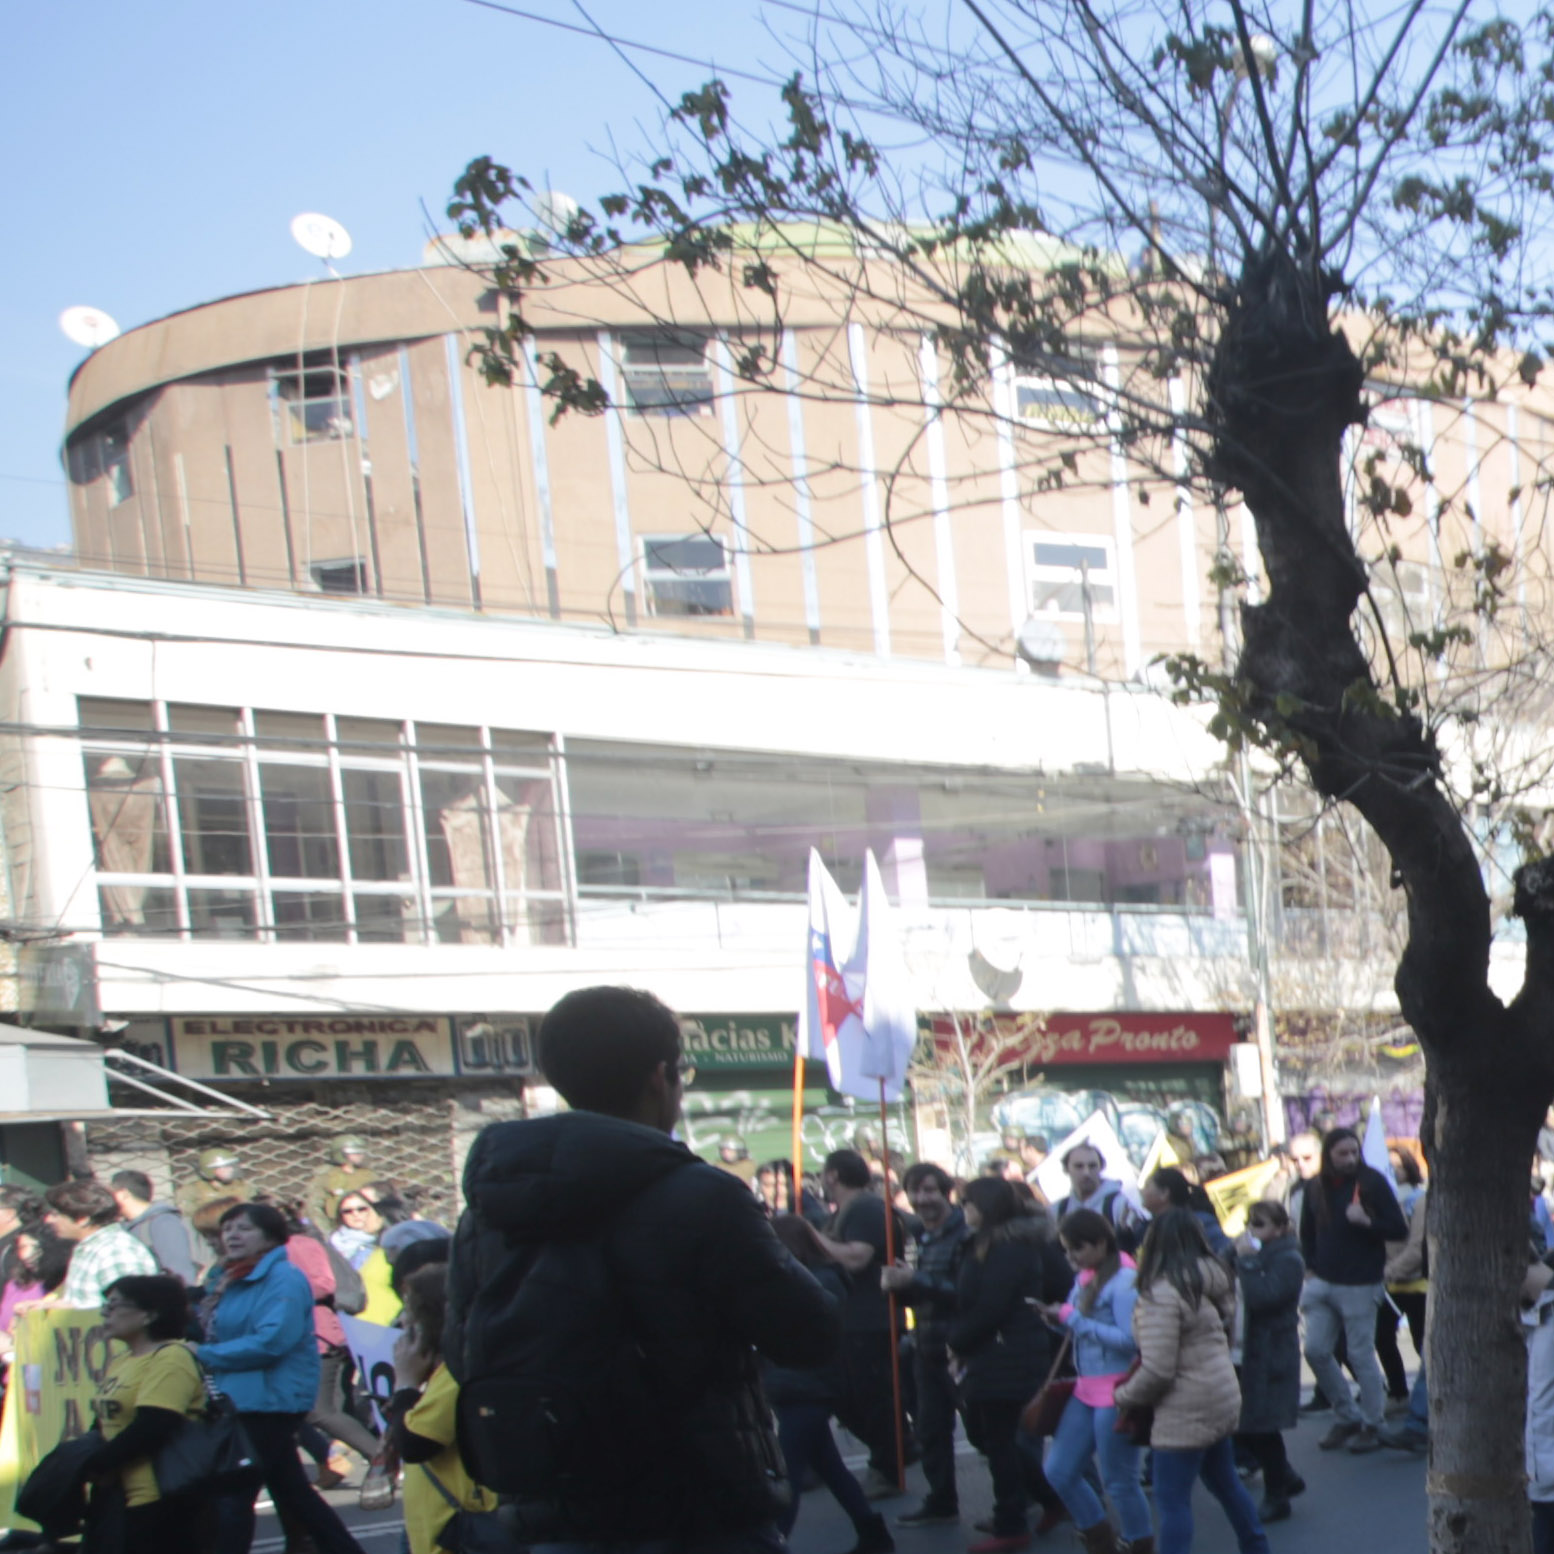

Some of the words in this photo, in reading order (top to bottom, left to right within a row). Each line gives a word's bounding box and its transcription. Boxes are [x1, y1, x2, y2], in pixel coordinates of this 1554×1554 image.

[183, 1018, 439, 1036] ELECTRONICA
[1088, 1017, 1201, 1054] Pronto
[210, 1038, 434, 1075] RICHA
